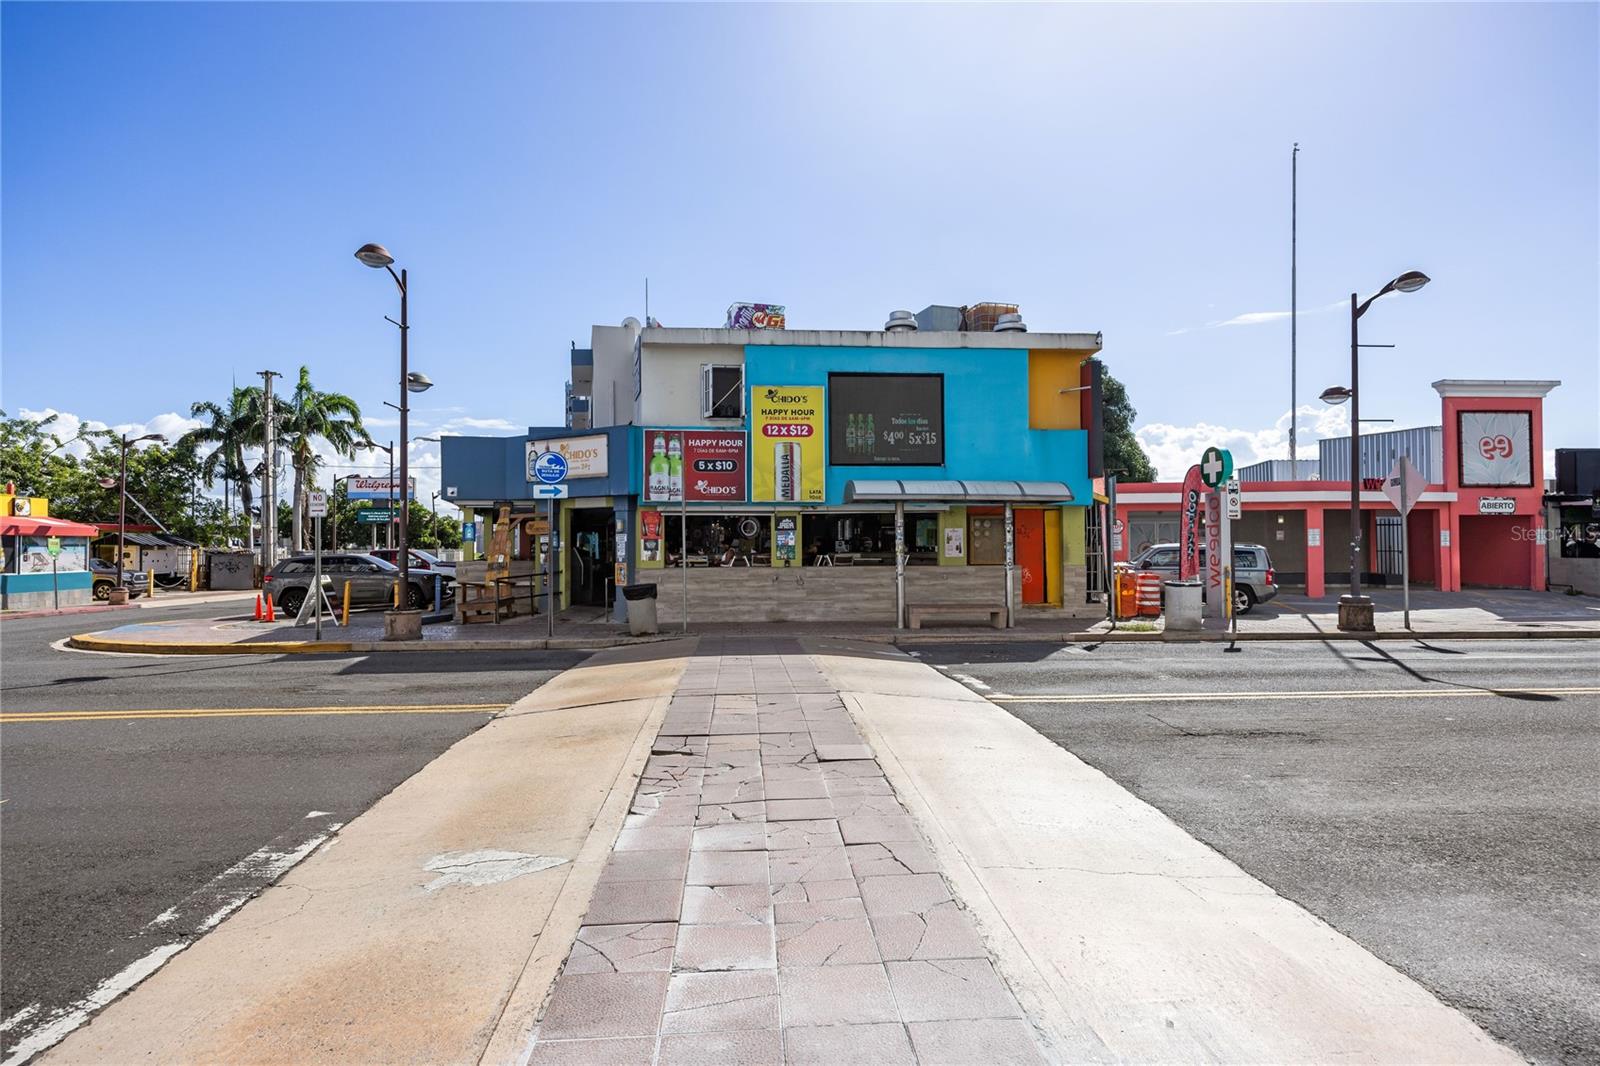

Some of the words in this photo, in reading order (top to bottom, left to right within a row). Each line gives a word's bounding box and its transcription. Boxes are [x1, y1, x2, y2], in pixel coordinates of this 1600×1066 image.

[771, 395, 808, 404] CHIDO'S
[767, 425, 779, 435] 12
[790, 425, 808, 436] $12
[688, 439, 717, 447] HAPPY
[719, 439, 743, 447] HOUR
[698, 461, 705, 470] 5
[715, 461, 733, 471] $10
[781, 454, 790, 498] MEDALLA
[355, 480, 401, 491] Walgreen
[701, 486, 737, 495] CHIDO'S
[312, 494, 323, 502] NO
[1481, 502, 1514, 510] ABIERTO
